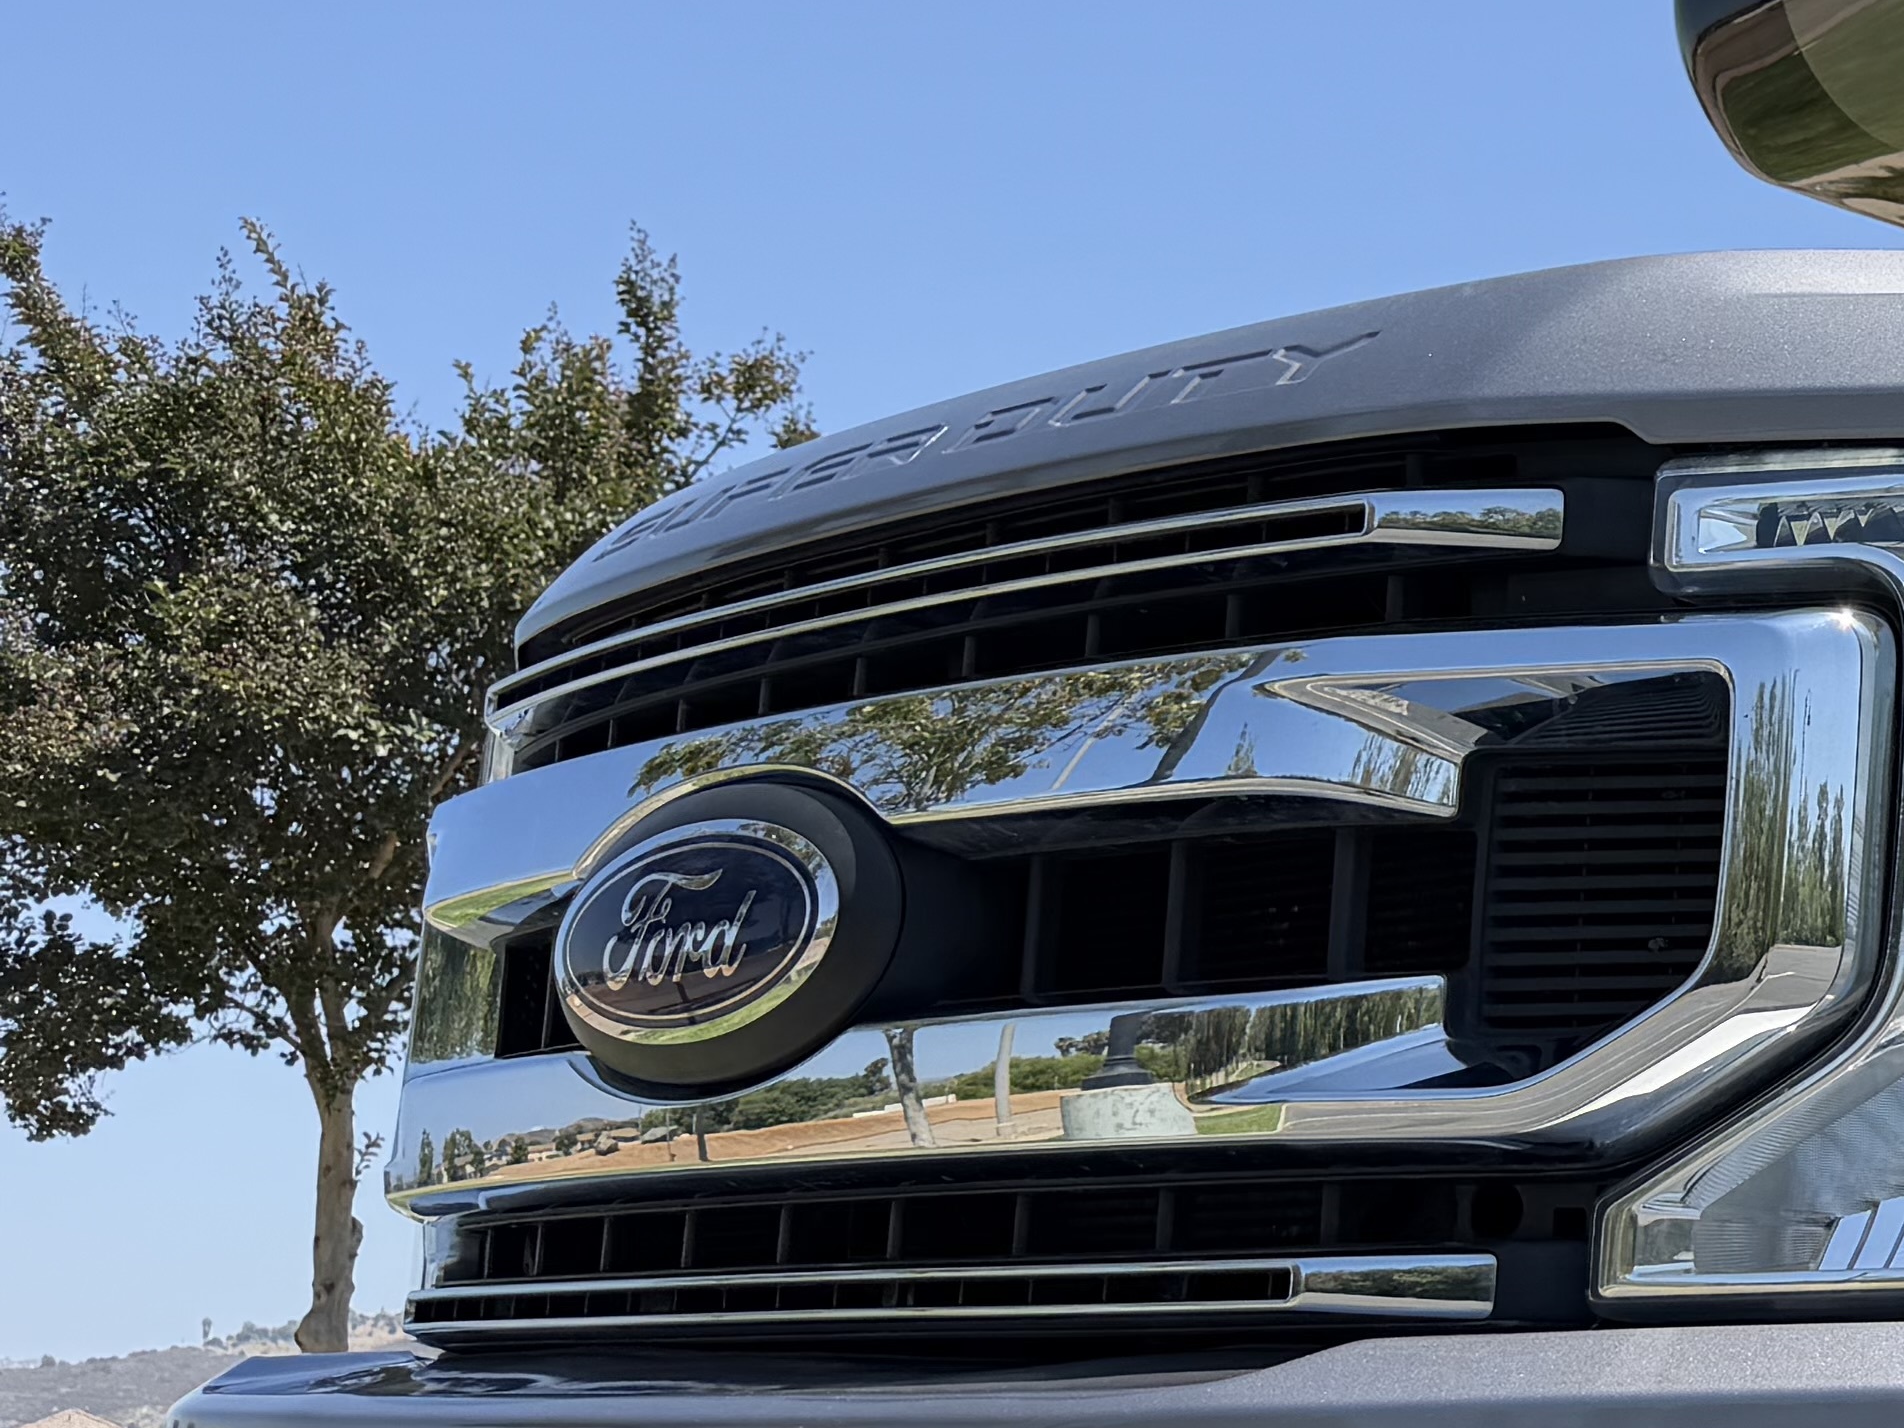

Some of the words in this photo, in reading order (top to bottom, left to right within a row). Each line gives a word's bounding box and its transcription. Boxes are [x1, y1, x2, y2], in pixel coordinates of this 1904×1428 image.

[594, 424, 948, 564] SUPER
[942, 328, 1382, 454] DUTY
[602, 868, 757, 991] Ford
